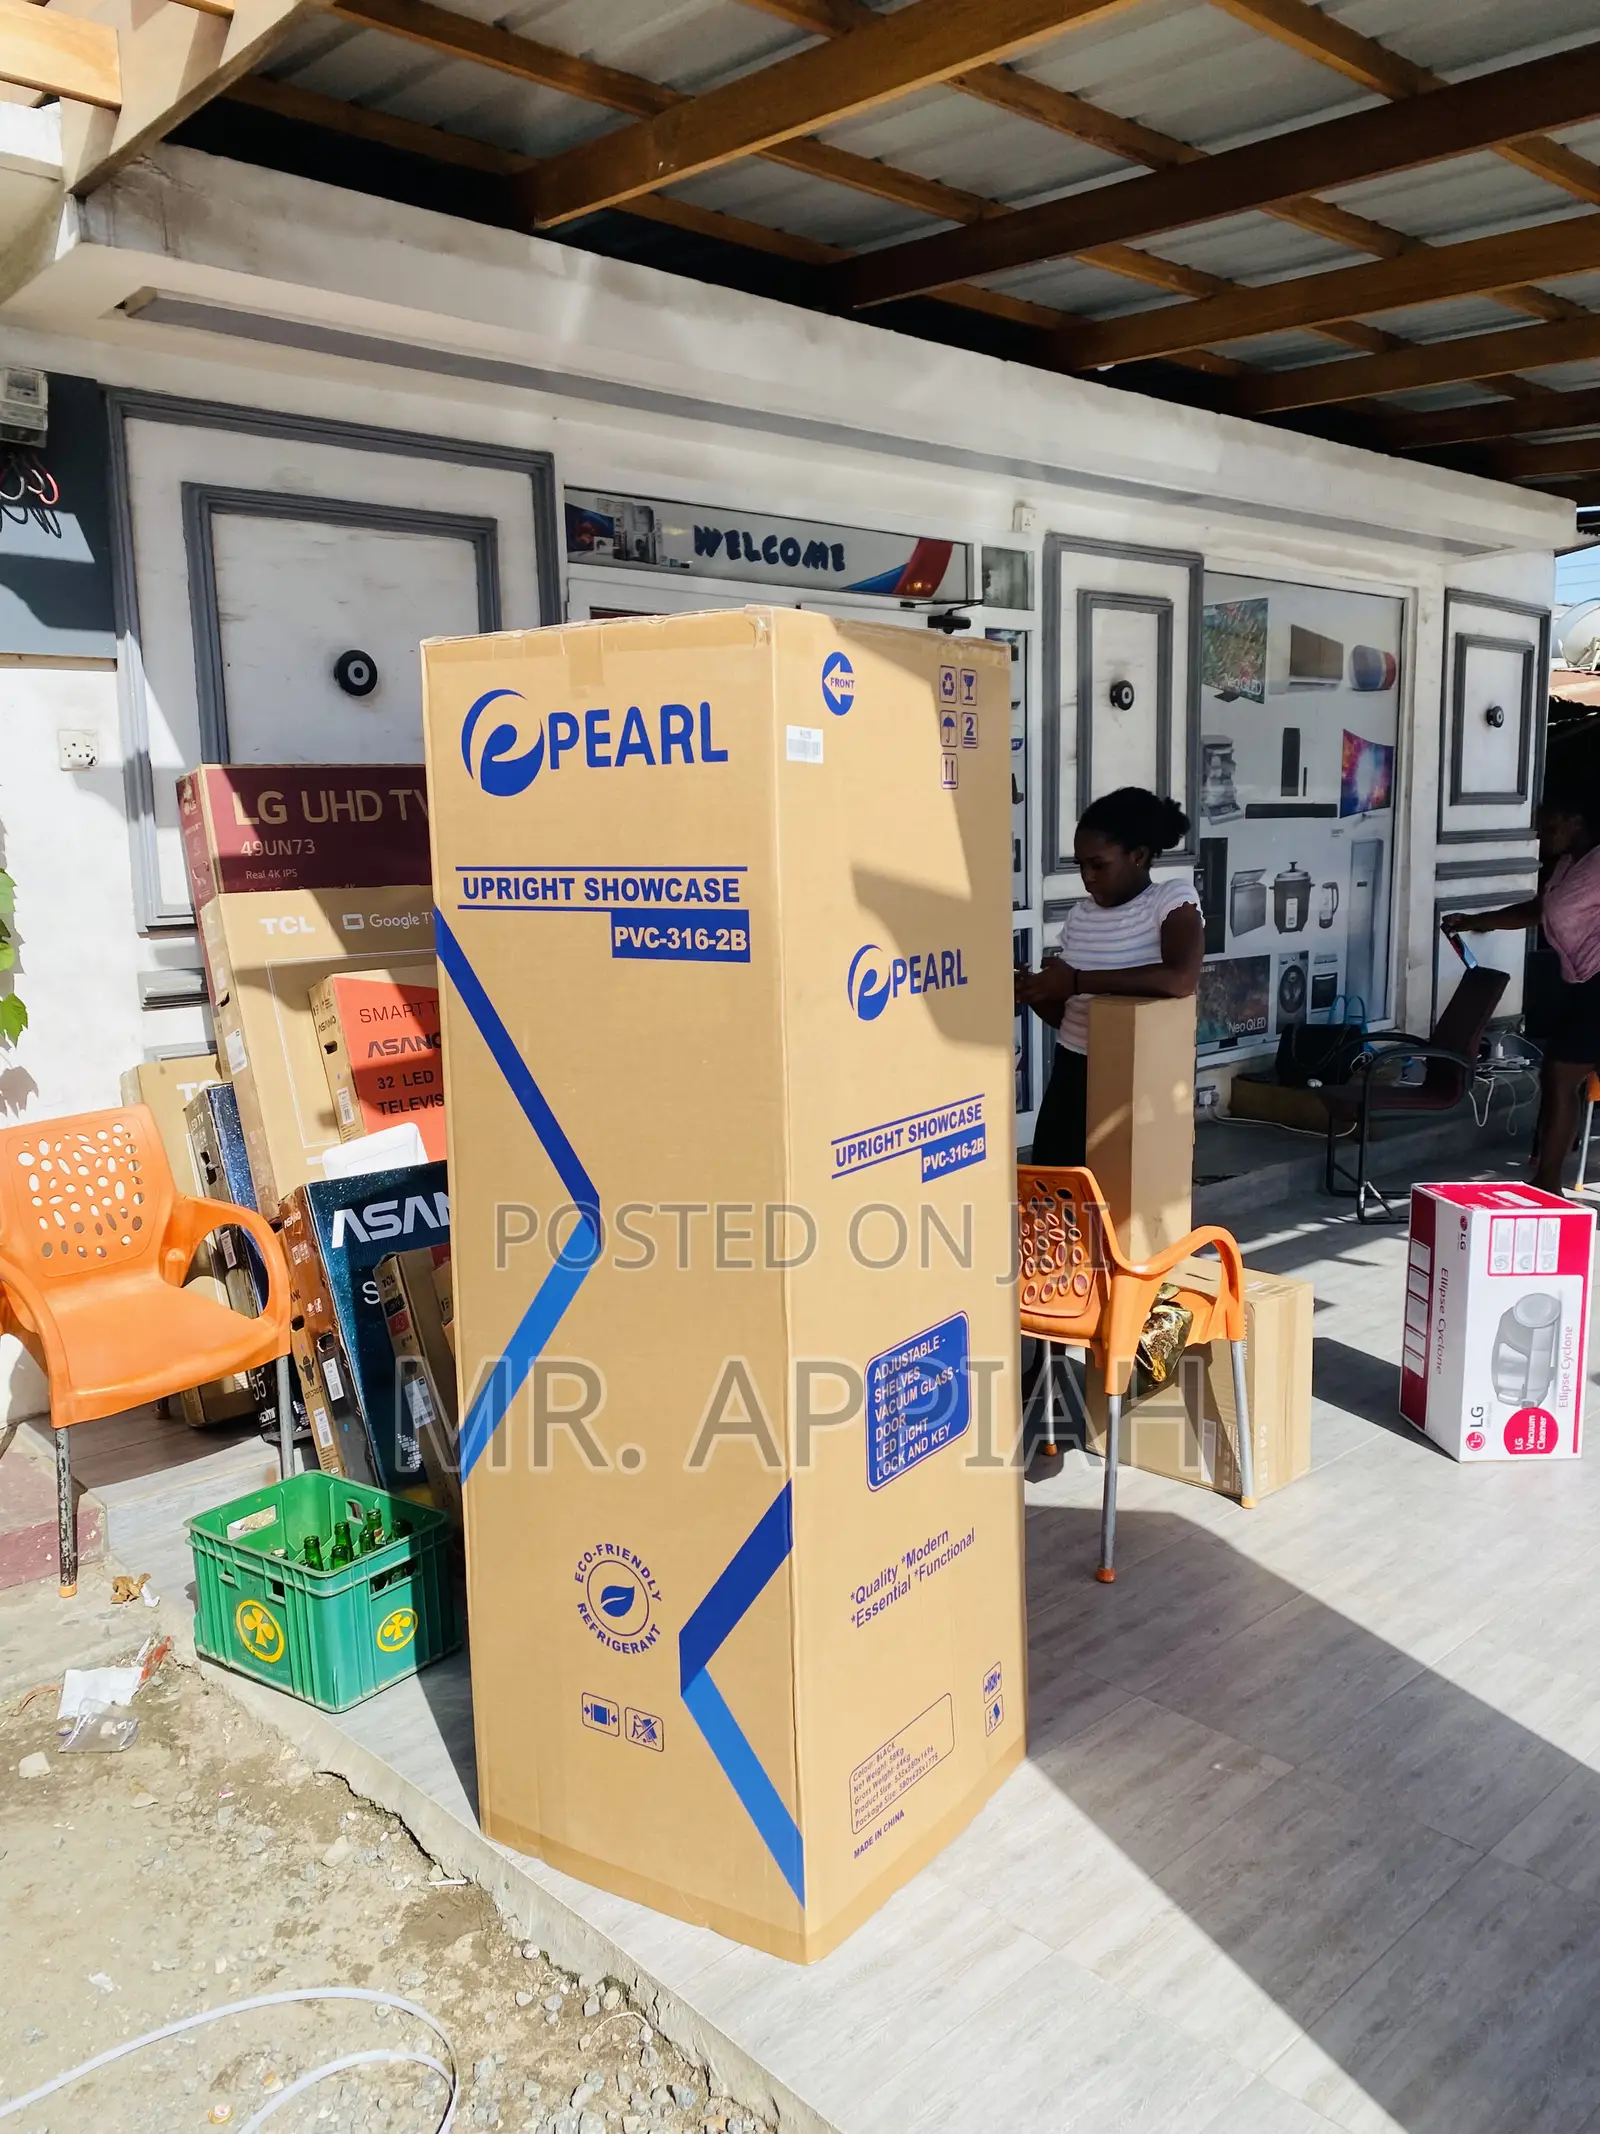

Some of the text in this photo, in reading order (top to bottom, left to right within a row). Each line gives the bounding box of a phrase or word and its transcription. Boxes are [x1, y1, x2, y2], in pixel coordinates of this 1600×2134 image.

[693, 524, 846, 572] WELCOME
[830, 677, 855, 689] FRONT
[548, 701, 729, 770] PEARL
[231, 790, 288, 826] LG
[300, 789, 383, 824] UHD
[240, 838, 316, 857] 49UN73
[245, 868, 298, 880] Real 4K IPS
[462, 875, 741, 903] UPRIGHT SHOWCASE
[259, 916, 316, 935] TCL
[369, 912, 420, 930] Google
[613, 925, 748, 952] PVC-316-2B
[892, 948, 968, 999] PEARL
[359, 1001, 428, 1024] SMART
[377, 1070, 435, 1090] 32 LED
[376, 1093, 445, 1116] TELEVIS
[835, 1102, 983, 1168] UPRIGHT SHOWCASE
[922, 1136, 985, 1174] PVC-316-2B
[1460, 1233, 1467, 1250] LG
[382, 1274, 395, 1289] TCL
[1435, 1267, 1449, 1375] Ellipse Cyclone
[873, 1335, 940, 1384] ADJUSTABLE
[1558, 1325, 1574, 1408] Ellipse Cyclone
[874, 1365, 921, 1404] SHELVES
[874, 1385, 918, 1423] VACUUM
[920, 1366, 954, 1396] GLASS
[875, 1412, 907, 1443] DOOR
[1470, 1406, 1484, 1428] LG
[1525, 1414, 1536, 1451] Vacuum
[1536, 1415, 1547, 1450] Cleaner
[876, 1417, 929, 1462] LED LIGHT
[876, 1421, 952, 1482] LOCK AND KEY
[1514, 1437, 1524, 1451] LG
[574, 1543, 662, 1602] ECO-FRIENDLY
[576, 1602, 661, 1654] REFRIGERANT
[876, 1742, 896, 1763] BLACK
[853, 1779, 865, 1794] Net
[854, 1788, 872, 1805] Gross
[855, 1791, 879, 1817] Product
[855, 1801, 883, 1830] Package
[853, 1809, 905, 1860] MADE IN CHINA
